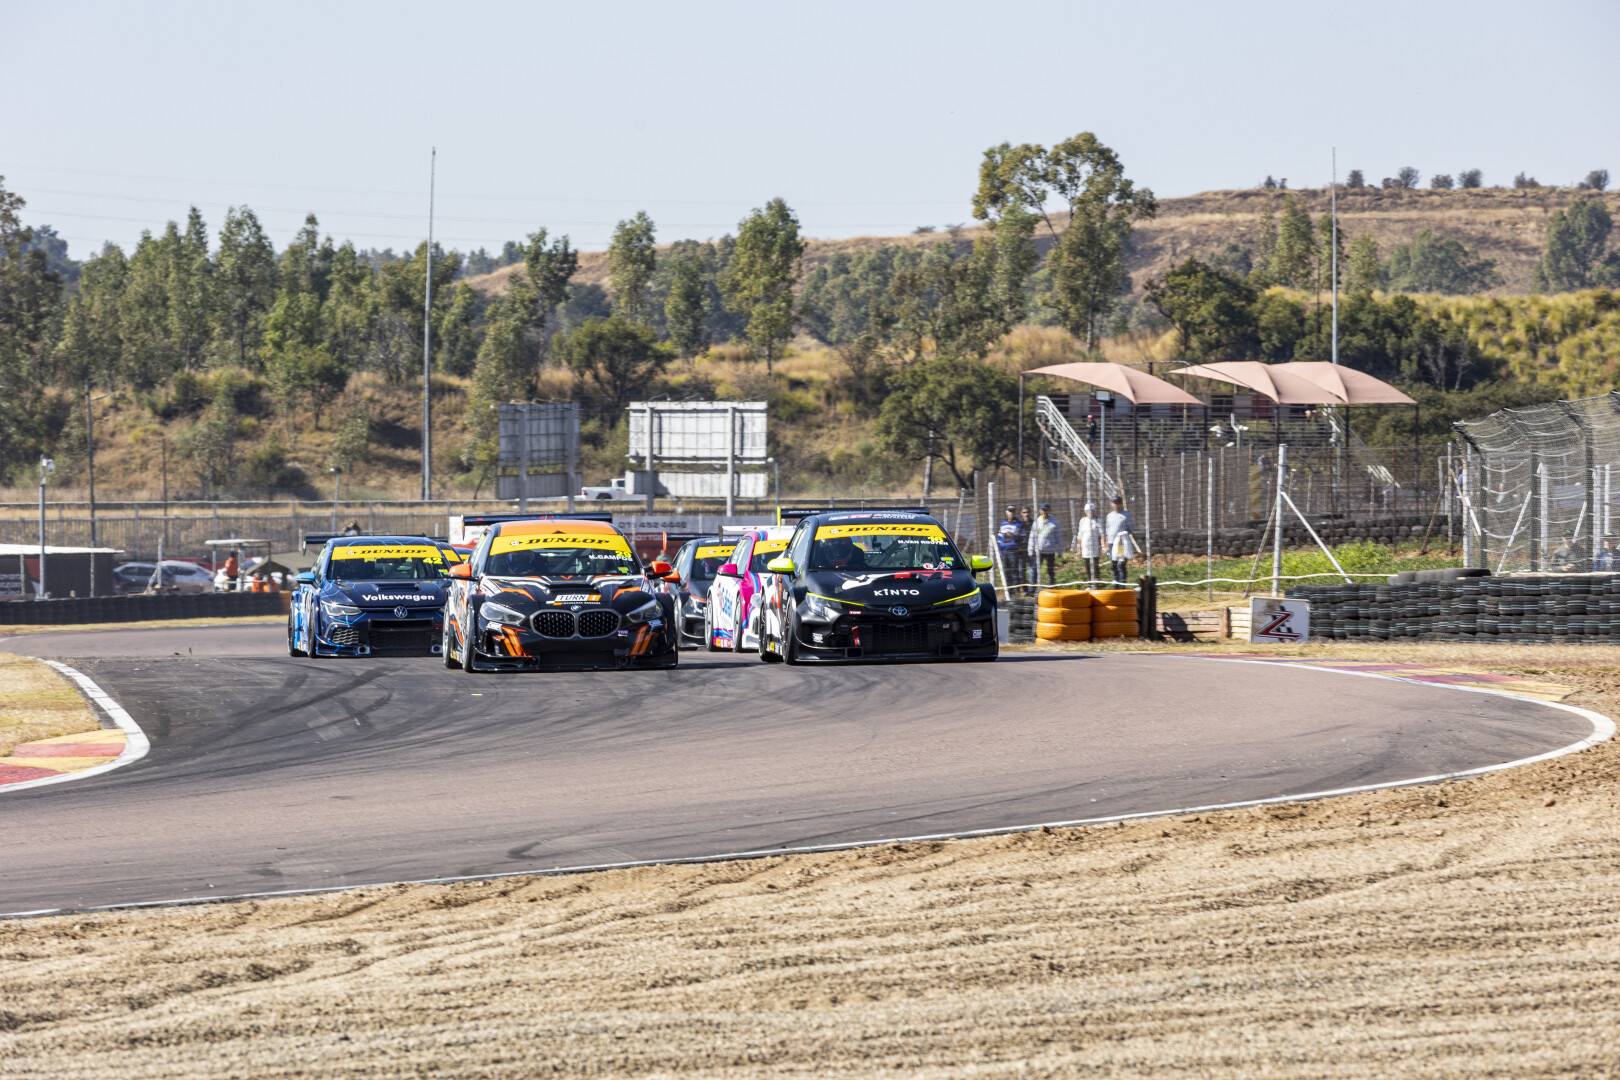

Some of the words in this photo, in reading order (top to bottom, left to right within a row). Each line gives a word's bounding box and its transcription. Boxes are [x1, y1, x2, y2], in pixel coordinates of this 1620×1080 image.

[526, 537, 610, 545] DUNLOP
[422, 557, 443, 565] 42
[874, 588, 920, 597] KINTO
[362, 594, 435, 602] Volkswagen
